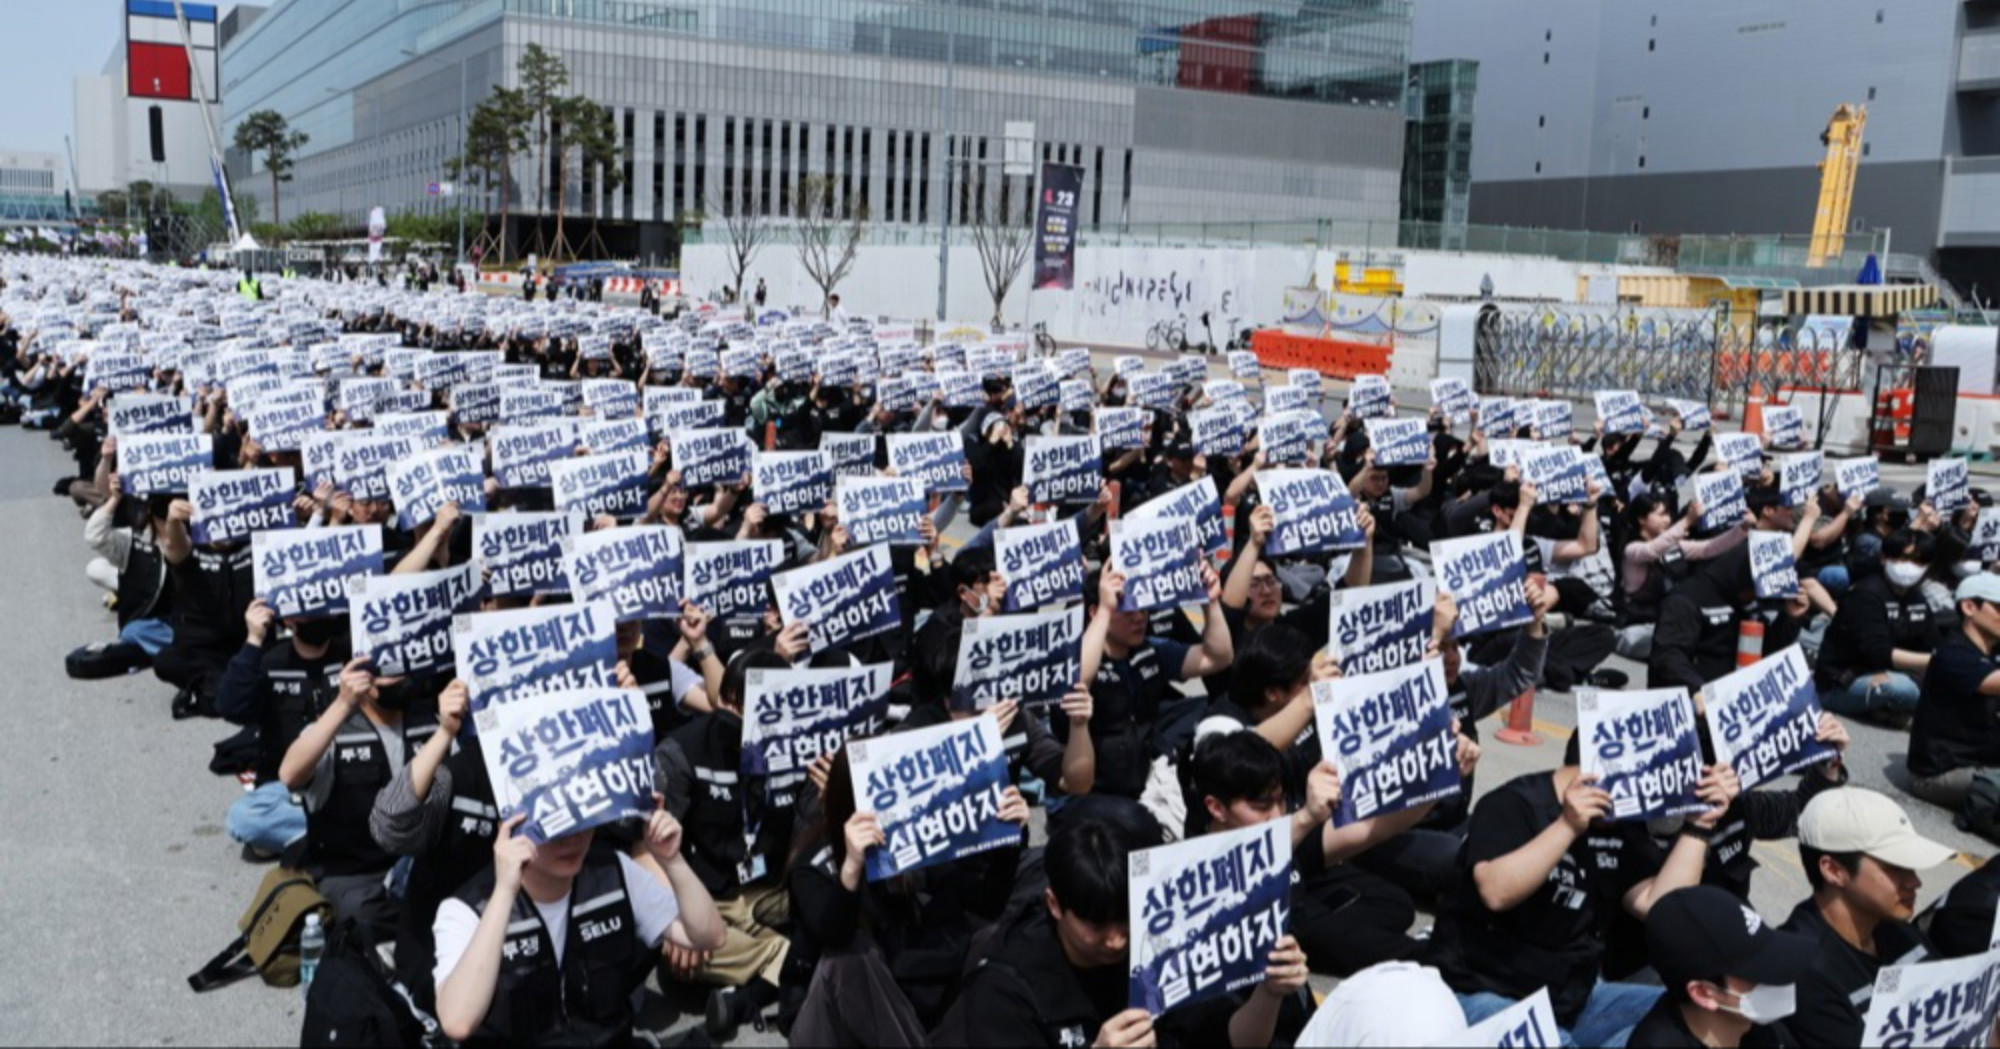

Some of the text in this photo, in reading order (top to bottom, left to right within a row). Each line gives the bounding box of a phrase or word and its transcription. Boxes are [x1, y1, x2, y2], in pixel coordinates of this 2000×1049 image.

[113, 399, 181, 426] 상한폐지
[454, 386, 499, 404] 상한폐지
[667, 402, 718, 427] 상한폐지
[254, 405, 314, 429] 상한폐지
[586, 422, 638, 447] 상한폐지
[124, 436, 200, 464] 상한폐지
[341, 440, 412, 469] 상한폐지
[496, 428, 563, 458] 상한폐지
[677, 431, 738, 460] 상한폐지
[894, 436, 953, 463] 상한폐지
[1031, 439, 1093, 472] 상한폐지
[196, 472, 281, 509] 상한폐지
[395, 453, 472, 496] 상한폐지
[558, 456, 636, 494] 상한폐지
[684, 457, 745, 484] 실현하자
[758, 454, 824, 485] 상한폐지
[1033, 472, 1101, 500] 실현하자
[767, 484, 829, 514] 실현하자
[844, 480, 914, 511] 상한폐지
[1269, 474, 1343, 515] 상한폐지
[206, 505, 293, 540] 실현하자
[480, 516, 570, 557] 상한폐지
[851, 511, 922, 540] 실현하자
[1120, 521, 1194, 567] 상한폐지
[1280, 506, 1358, 544] 실현하자
[262, 529, 366, 577] 상한폐지
[574, 530, 670, 585] 상한폐지
[692, 544, 772, 583] 상한폐지
[1002, 525, 1071, 572] 상한폐지
[1442, 538, 1515, 590] 상한폐지
[362, 567, 471, 633] 상한폐지
[787, 550, 878, 616] 상한폐지
[1014, 564, 1082, 607] 실현하자
[809, 588, 898, 651] 실현하자
[1336, 583, 1422, 646] 상한폐지
[1457, 582, 1526, 630] 실현하자
[467, 608, 595, 677] 상한폐지
[967, 618, 1073, 669] 상한폐지
[755, 670, 877, 724] 상한폐지
[1330, 667, 1436, 755] 상한폐지
[1717, 654, 1795, 744] 상한폐지
[501, 693, 637, 779] 상한폐지
[1592, 695, 1688, 759] 상한폐지
[1733, 703, 1820, 792] 실현하자
[865, 724, 986, 812] 상한폐지
[1350, 734, 1457, 820] 실현하자
[1609, 751, 1701, 816] 실현하자
[532, 755, 655, 838] 실현하자
[888, 783, 1003, 869] 실현하자
[1142, 829, 1274, 935] 상한폐지
[580, 917, 622, 943] SELU
[1157, 899, 1287, 1007] 실현하자
